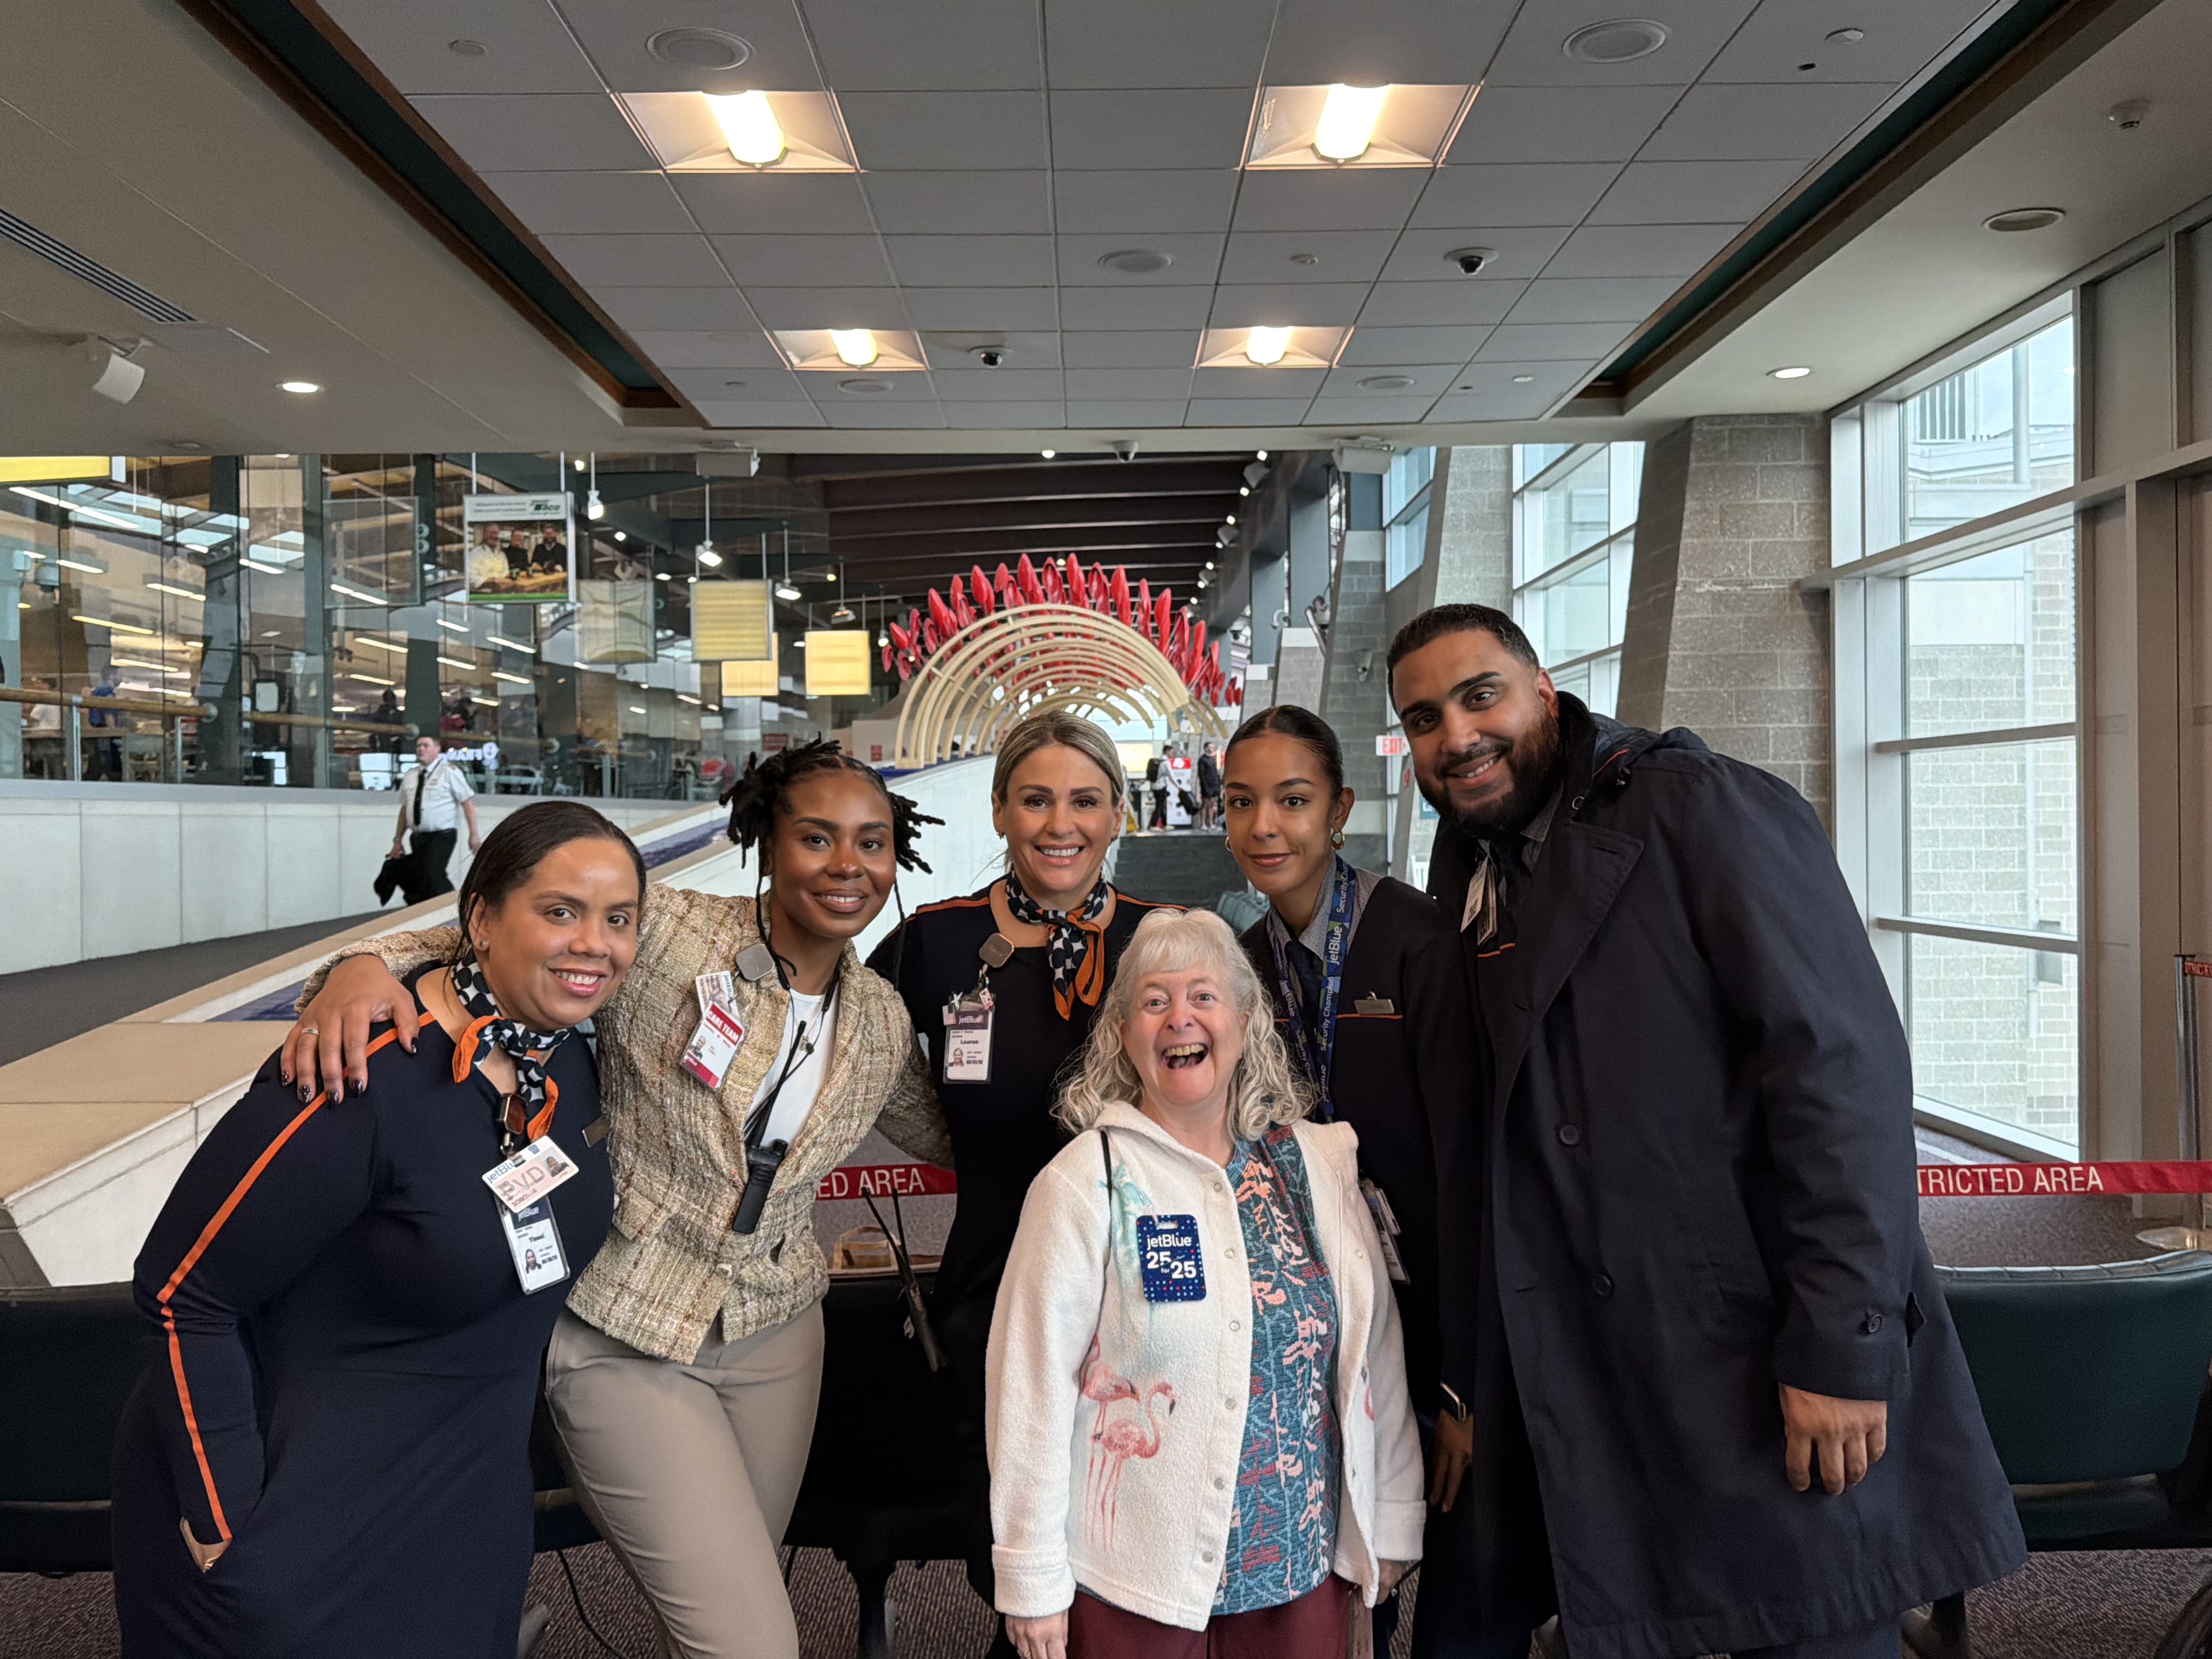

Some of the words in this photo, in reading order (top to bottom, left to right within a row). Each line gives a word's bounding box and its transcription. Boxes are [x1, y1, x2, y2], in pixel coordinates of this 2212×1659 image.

[1382, 737, 1403, 755] EXIT
[1336, 881, 1349, 913] Security
[1327, 926, 1342, 966] jetBlue
[723, 975, 733, 999] jetBlu
[1280, 981, 1295, 1017] jetBlue
[1323, 977, 1334, 1017] Champion
[707, 1010, 724, 1030] CARE
[722, 1023, 740, 1043] TEAM
[958, 1015, 984, 1025] jetBlue
[1321, 1018, 1330, 1052] Security
[1295, 1029, 1307, 1061] Security
[1320, 1064, 1330, 1103] jetBlue
[486, 1160, 515, 1185] jetBlu
[501, 1166, 546, 1199] PVD
[858, 1167, 925, 1197] AREA
[1916, 1167, 2024, 1194] TRICTED
[2033, 1166, 2104, 1193] AREA
[518, 1206, 539, 1222] jetBlue
[1147, 1233, 1192, 1251] jetBlue
[1146, 1251, 1172, 1269] 25
[1170, 1261, 1197, 1279] 25
